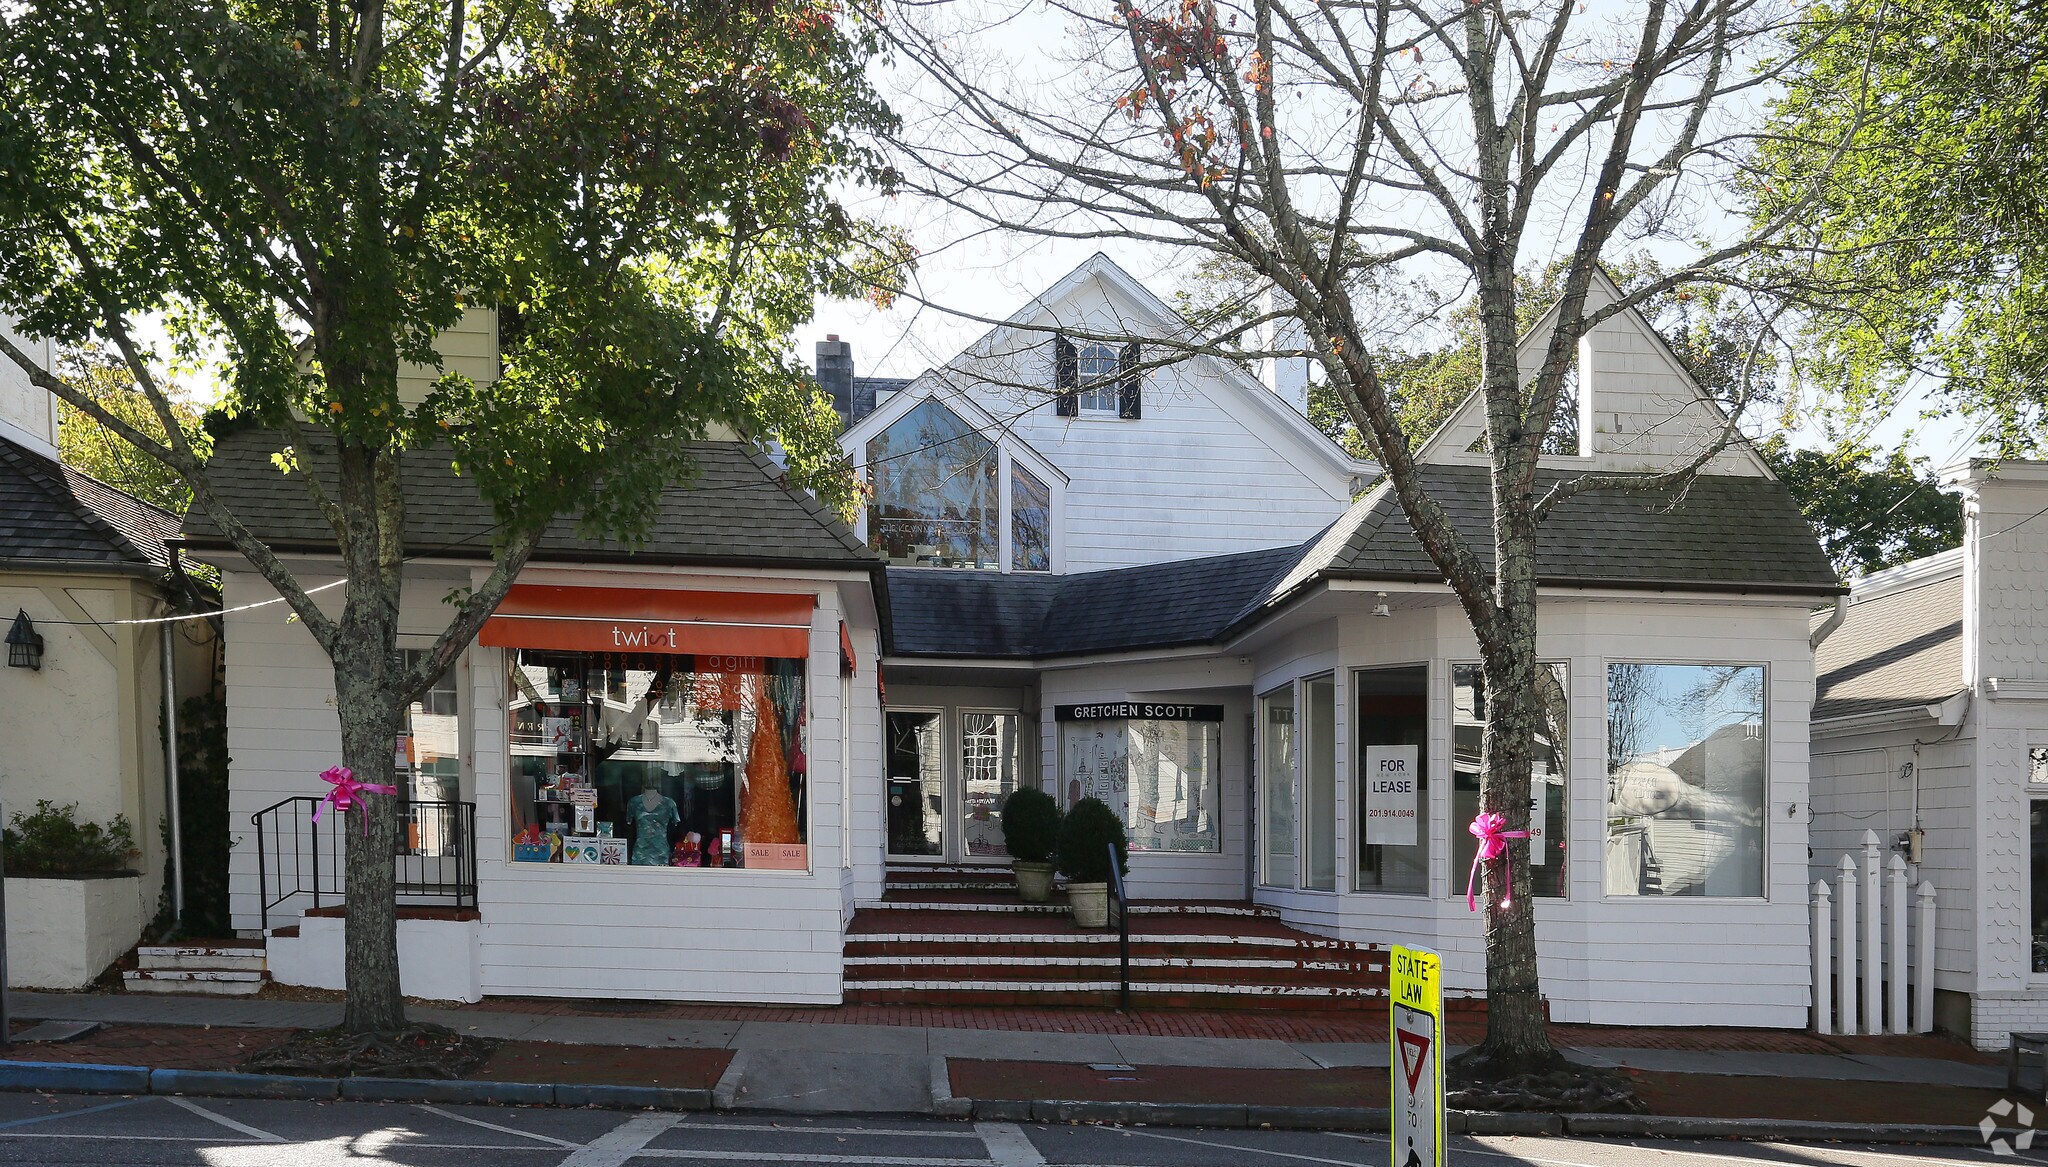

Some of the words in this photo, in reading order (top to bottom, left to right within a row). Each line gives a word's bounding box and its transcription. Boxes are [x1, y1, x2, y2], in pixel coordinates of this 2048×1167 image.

[612, 626, 677, 648] twist
[1074, 704, 1138, 719] GRETCHEN
[1144, 705, 1195, 718] SCOTT
[1380, 759, 1405, 772] FOR
[1373, 781, 1412, 793] LEASE
[1369, 809, 1415, 818] 201.914.0049
[751, 849, 769, 857] SALE
[782, 849, 801, 858] SALE
[1397, 954, 1429, 981] STATE
[1401, 980, 1422, 1004] LAW
